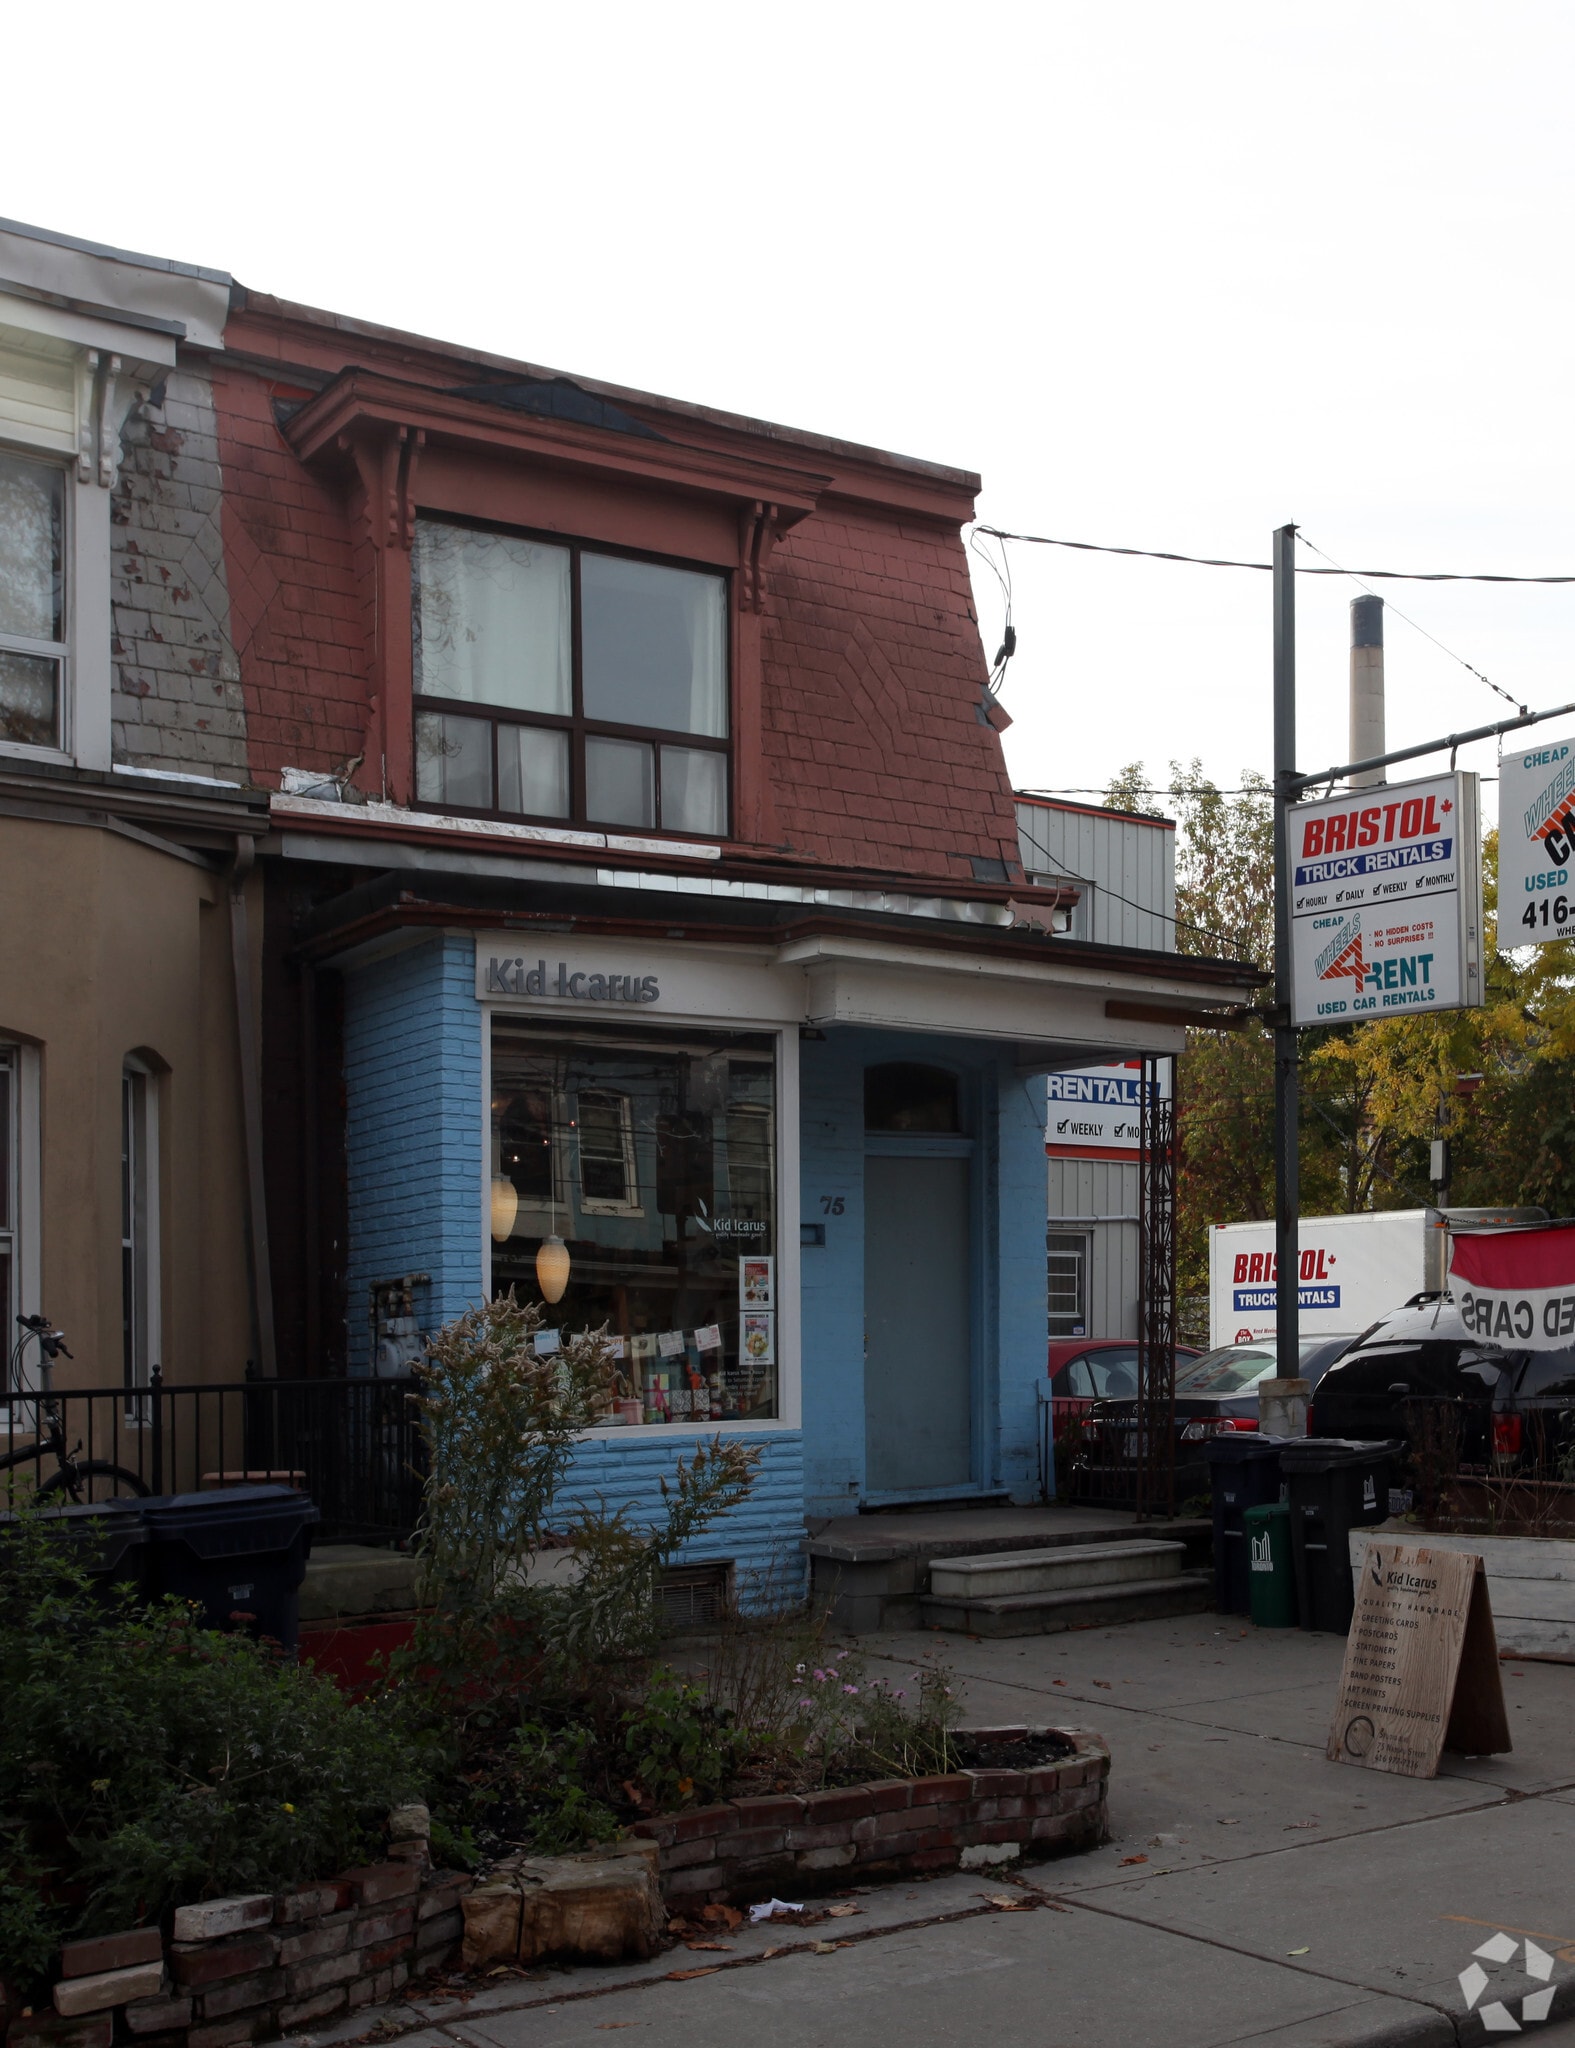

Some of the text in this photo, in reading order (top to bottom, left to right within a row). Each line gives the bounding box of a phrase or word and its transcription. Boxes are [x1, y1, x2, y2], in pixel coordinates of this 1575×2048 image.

[1523, 746, 1569, 769] CHEAP
[1302, 795, 1441, 859] BRISTOL
[1302, 842, 1444, 884] TRUCK RENTALS
[1524, 868, 1569, 892] USED
[1305, 872, 1455, 908] HOURLY DAILY WEEKLY MONTHLY
[1313, 916, 1344, 930] CHEAP
[1374, 921, 1434, 938] NO HIDDEN COSTS
[1314, 912, 1361, 978] WHEELS
[1374, 940, 1384, 948] NO
[1387, 933, 1425, 946] SURPRISES
[489, 957, 660, 1003] Kid Icarus
[1365, 953, 1434, 991] RENT
[1317, 988, 1435, 1015] USED CAR RENTALS
[1070, 1122, 1104, 1137] WEEKLY
[820, 1195, 845, 1216] 75
[713, 1218, 766, 1231] Kid Icarus
[1386, 1571, 1438, 1589] Kid Icarus
[1363, 1598, 1459, 1617] QUALITY HANDMADE
[1361, 1614, 1419, 1629] GREETING CARDS
[1358, 1628, 1399, 1641] POSTCARDS
[1355, 1642, 1398, 1656] STATIONERY
[1353, 1656, 1396, 1670] FINE PAPERS
[1350, 1670, 1402, 1686] BAND POSTERS
[1347, 1685, 1387, 1698] ART PRINTS
[1344, 1699, 1441, 1723] SCREEN PRINTING SUPPLIES
